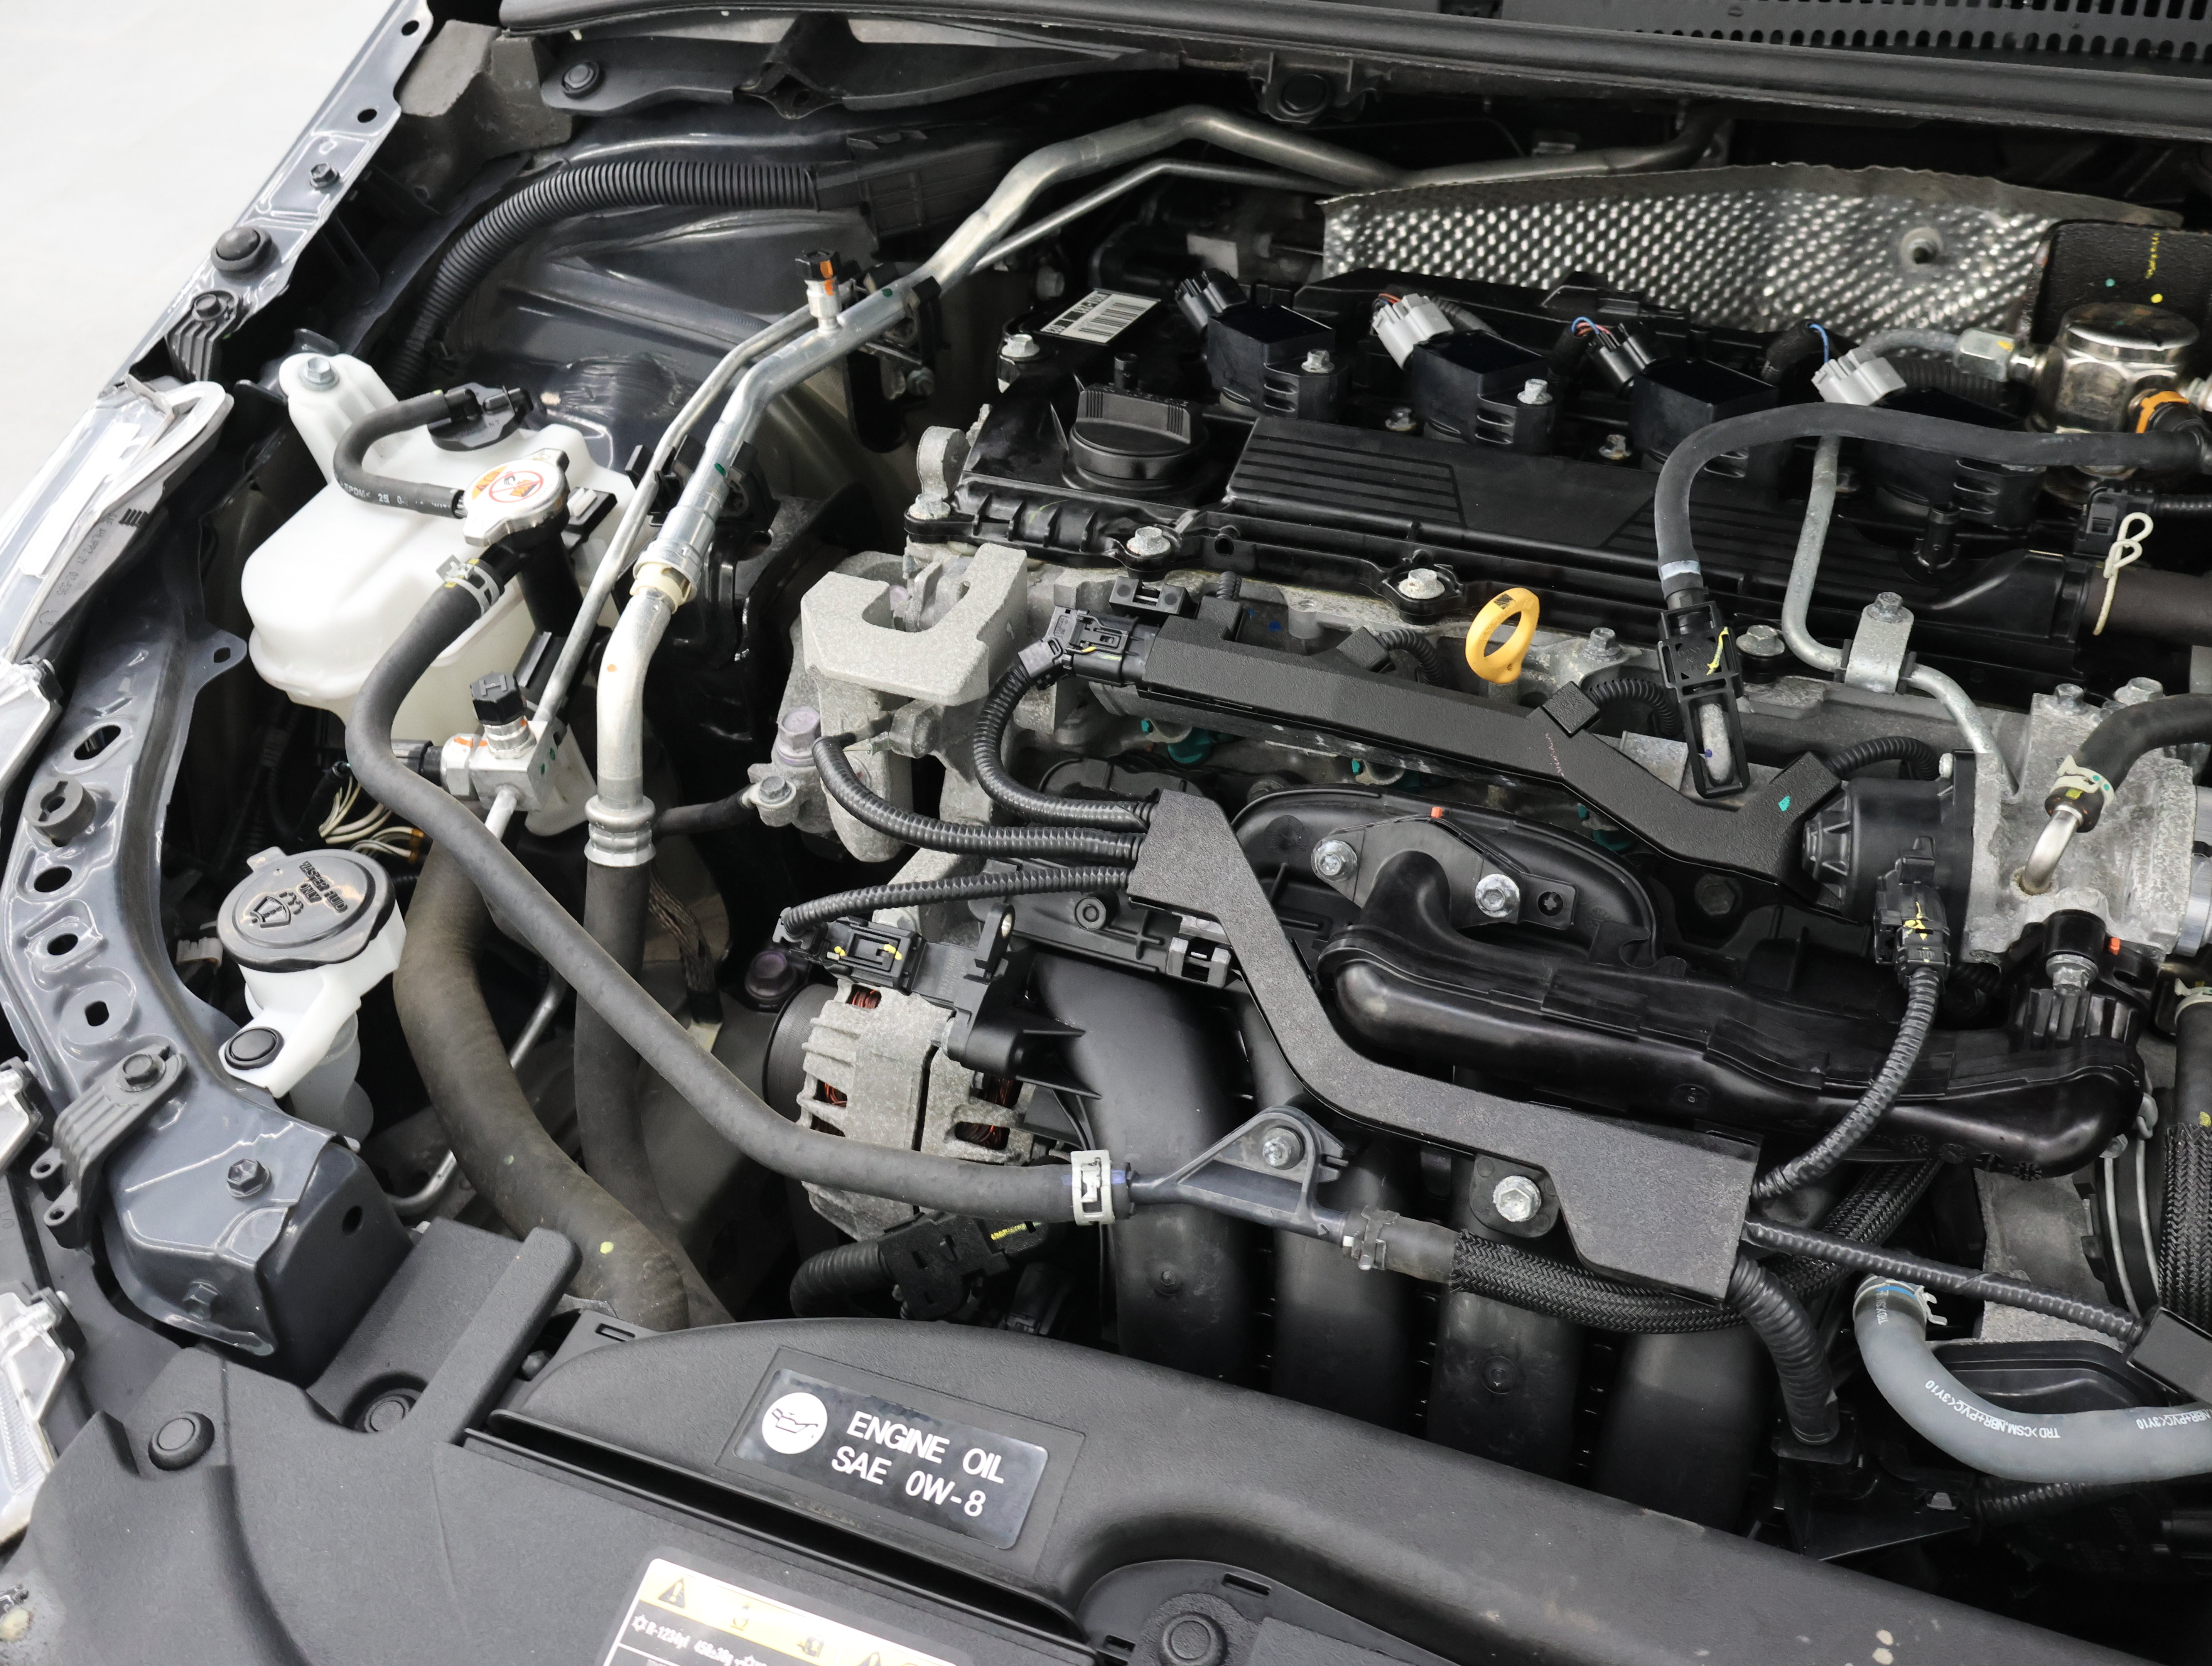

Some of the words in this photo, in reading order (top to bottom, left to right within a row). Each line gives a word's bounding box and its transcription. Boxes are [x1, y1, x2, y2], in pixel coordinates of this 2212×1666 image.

[300, 882, 322, 903] ONLY
[832, 1447, 891, 1485] SAE
[905, 1469, 986, 1517] 0W-8
[846, 1411, 950, 1463] ENGINE
[962, 1448, 1005, 1484] OIL
